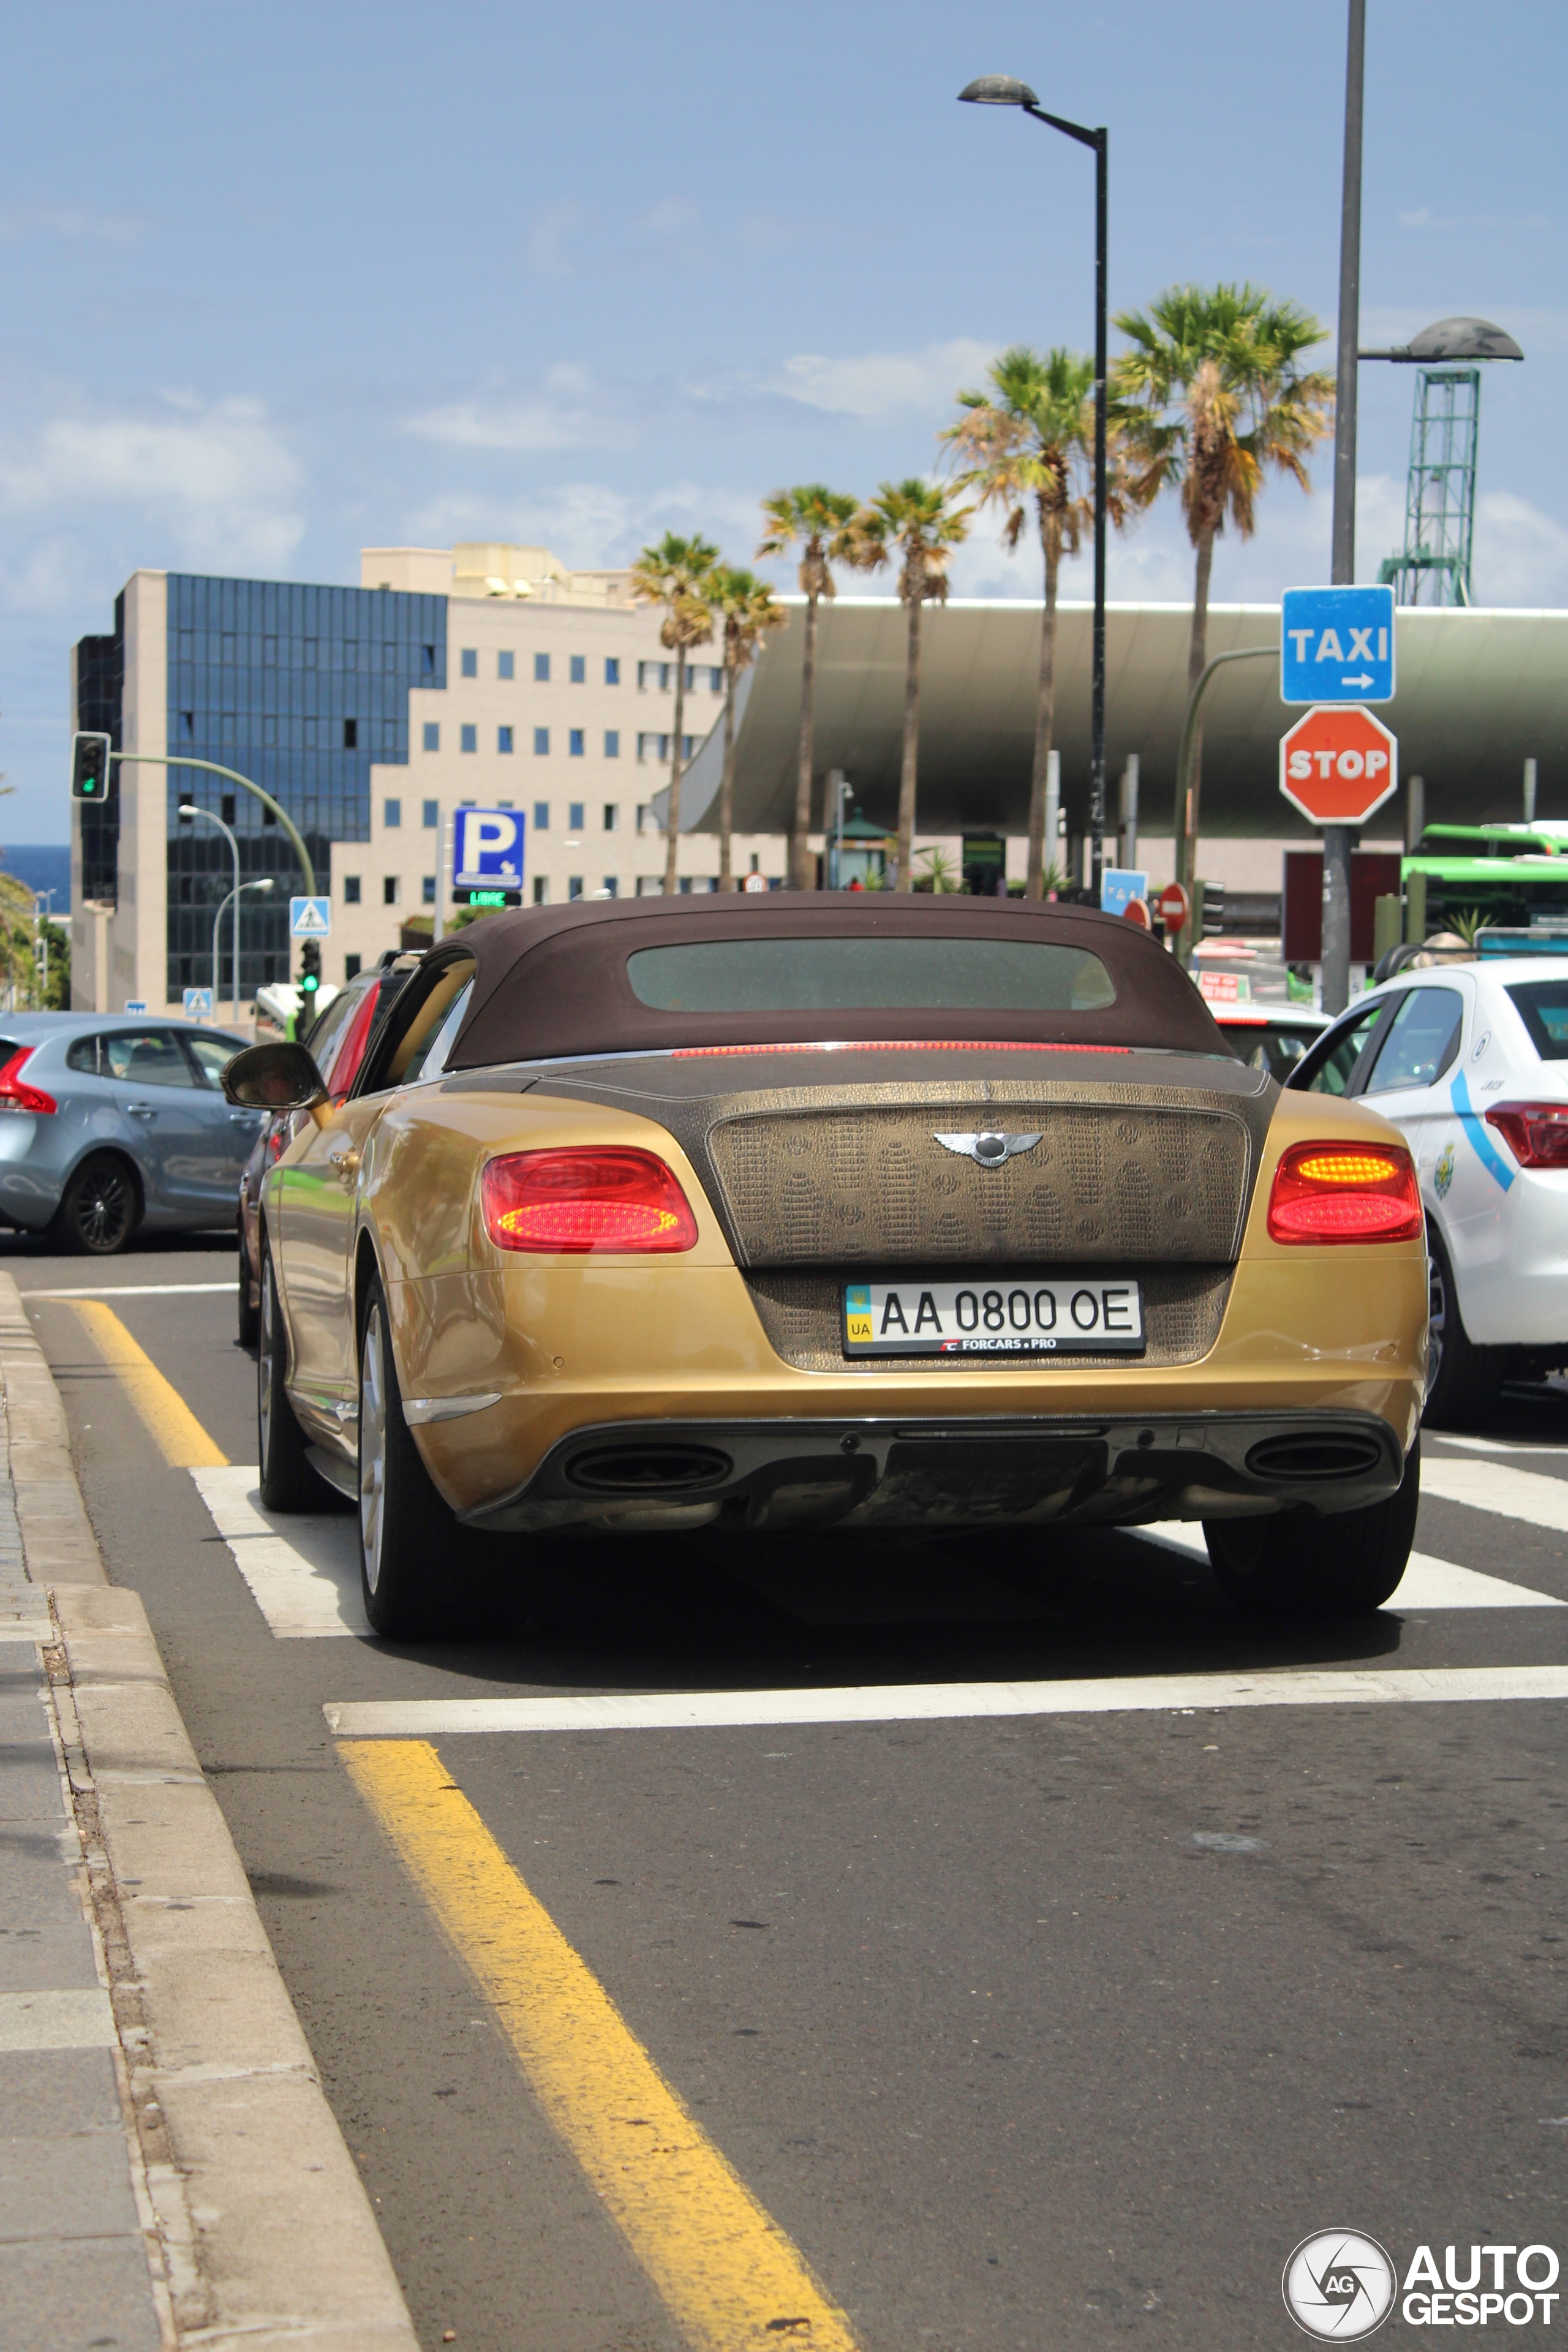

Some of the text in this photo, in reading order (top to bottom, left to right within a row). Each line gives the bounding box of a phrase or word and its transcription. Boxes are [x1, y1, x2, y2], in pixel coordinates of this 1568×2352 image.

[1287, 628, 1387, 662] TAXI
[1287, 750, 1387, 778] STOP
[464, 812, 516, 873] P
[470, 891, 505, 906] LIBRE
[880, 1289, 1133, 1335] AA 0800 OE
[851, 1324, 870, 1335] UA
